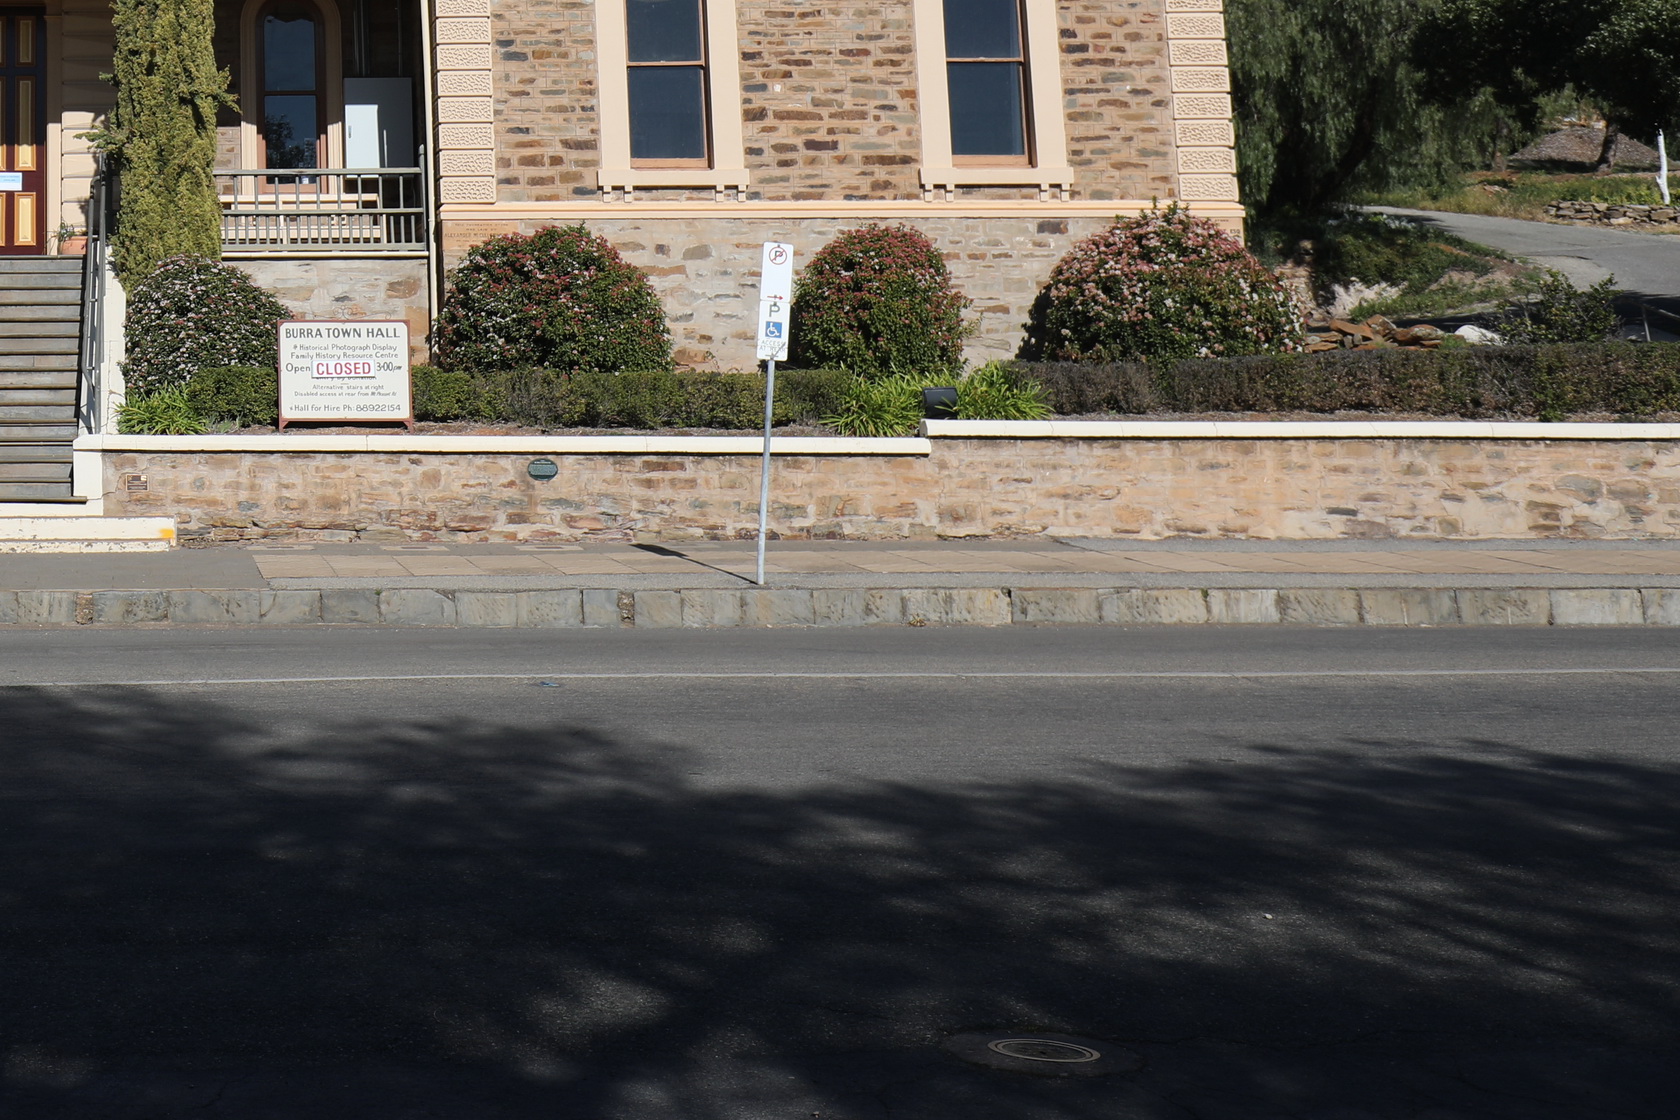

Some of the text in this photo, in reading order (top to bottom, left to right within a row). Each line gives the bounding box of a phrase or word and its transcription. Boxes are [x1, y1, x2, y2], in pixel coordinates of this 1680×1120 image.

[768, 304, 780, 317] P
[285, 327, 401, 339] BURRA TOWN HALL
[299, 343, 397, 352] Historical Photograph Display
[290, 352, 314, 360] Family
[315, 352, 341, 360] History
[374, 351, 399, 359] Centre
[285, 363, 311, 374] Open
[316, 362, 371, 375] CLOSED
[294, 404, 309, 412] Hall
[311, 404, 322, 412] for
[324, 404, 341, 412] Hire
